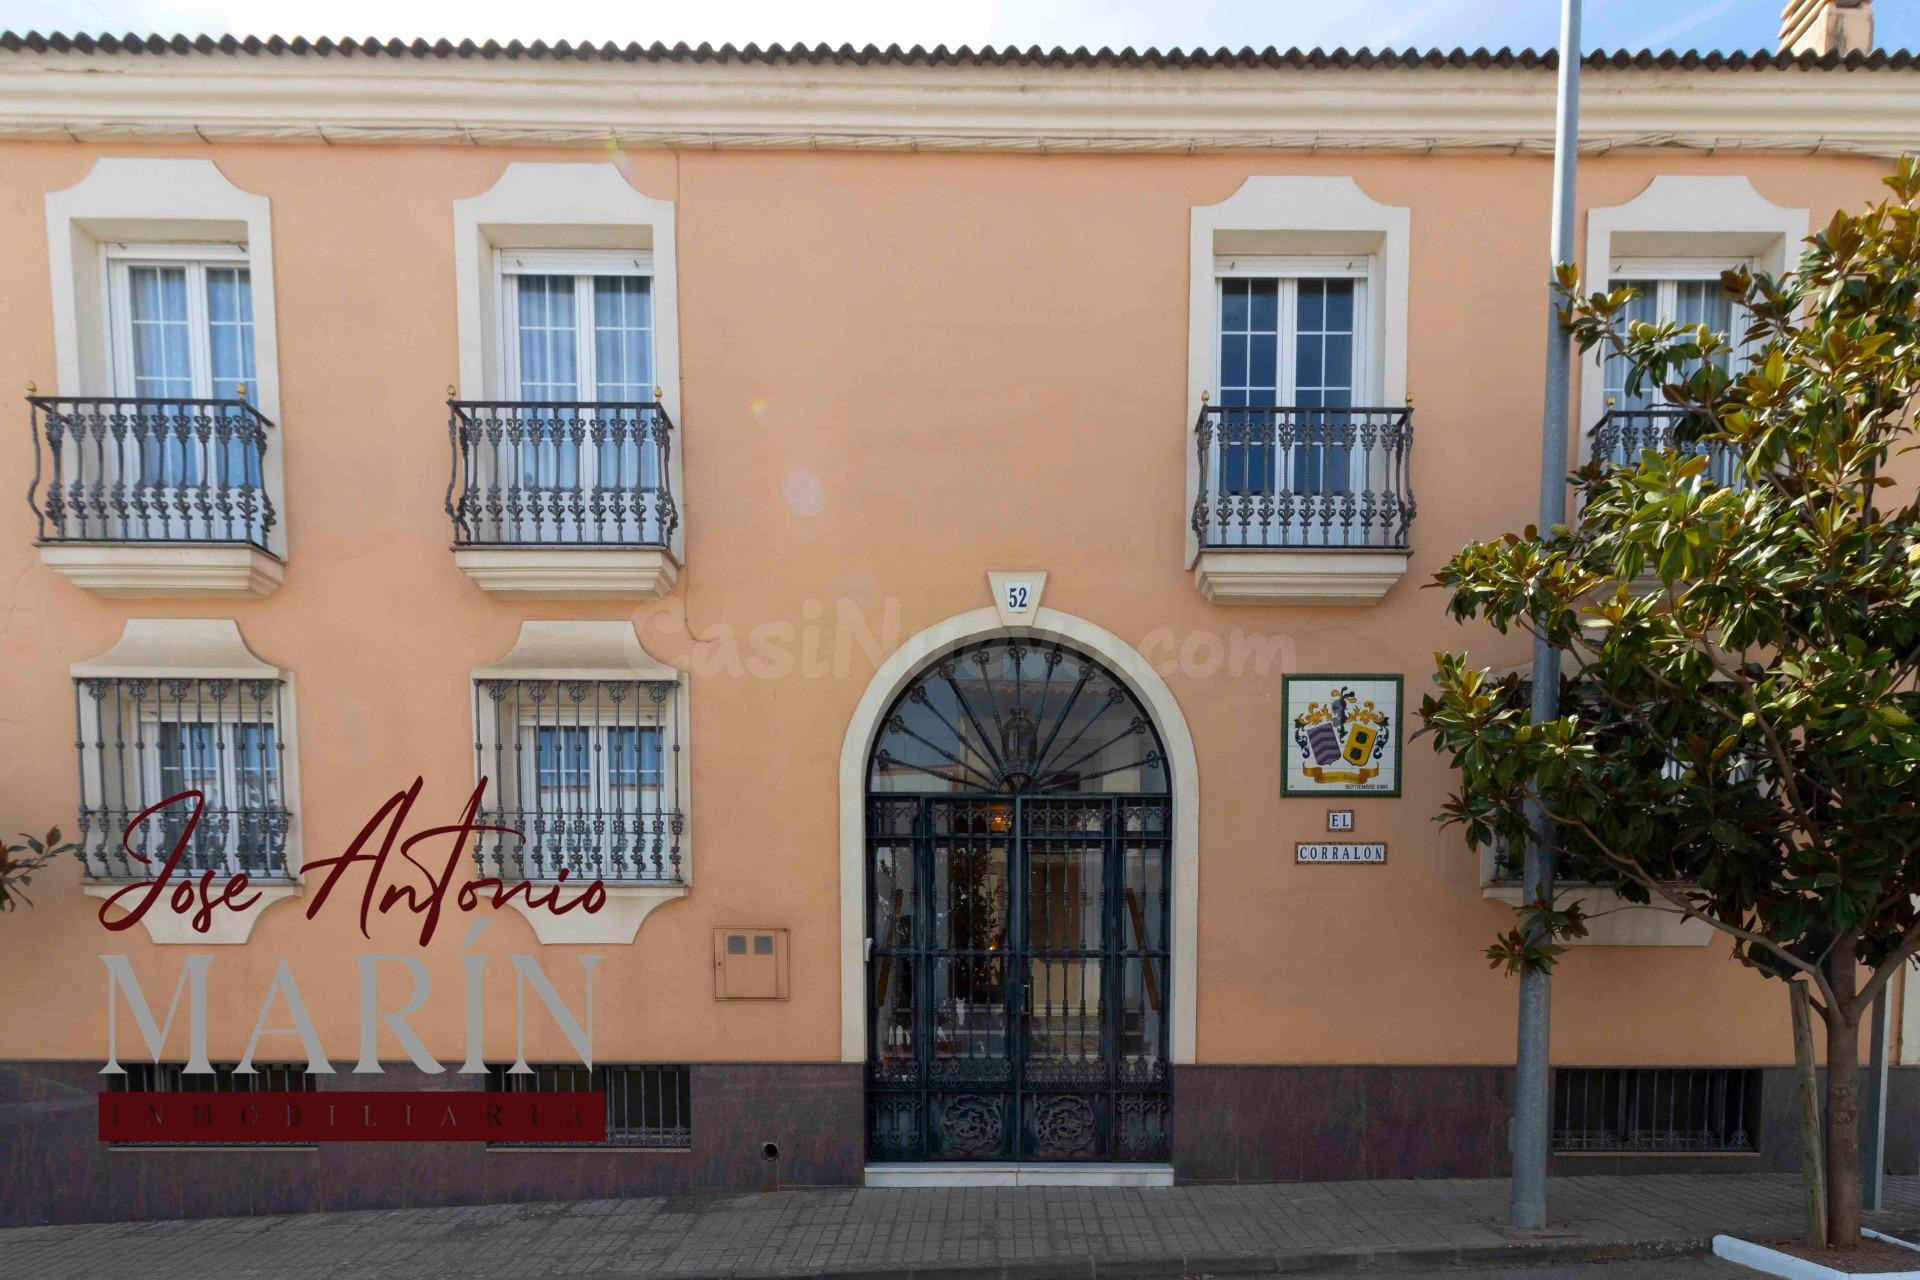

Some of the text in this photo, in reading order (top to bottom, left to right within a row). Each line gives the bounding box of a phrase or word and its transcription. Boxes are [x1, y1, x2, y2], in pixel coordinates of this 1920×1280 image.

[1009, 587, 1027, 608] 52
[1331, 814, 1349, 827] EL
[1300, 846, 1382, 860] CORRALON
